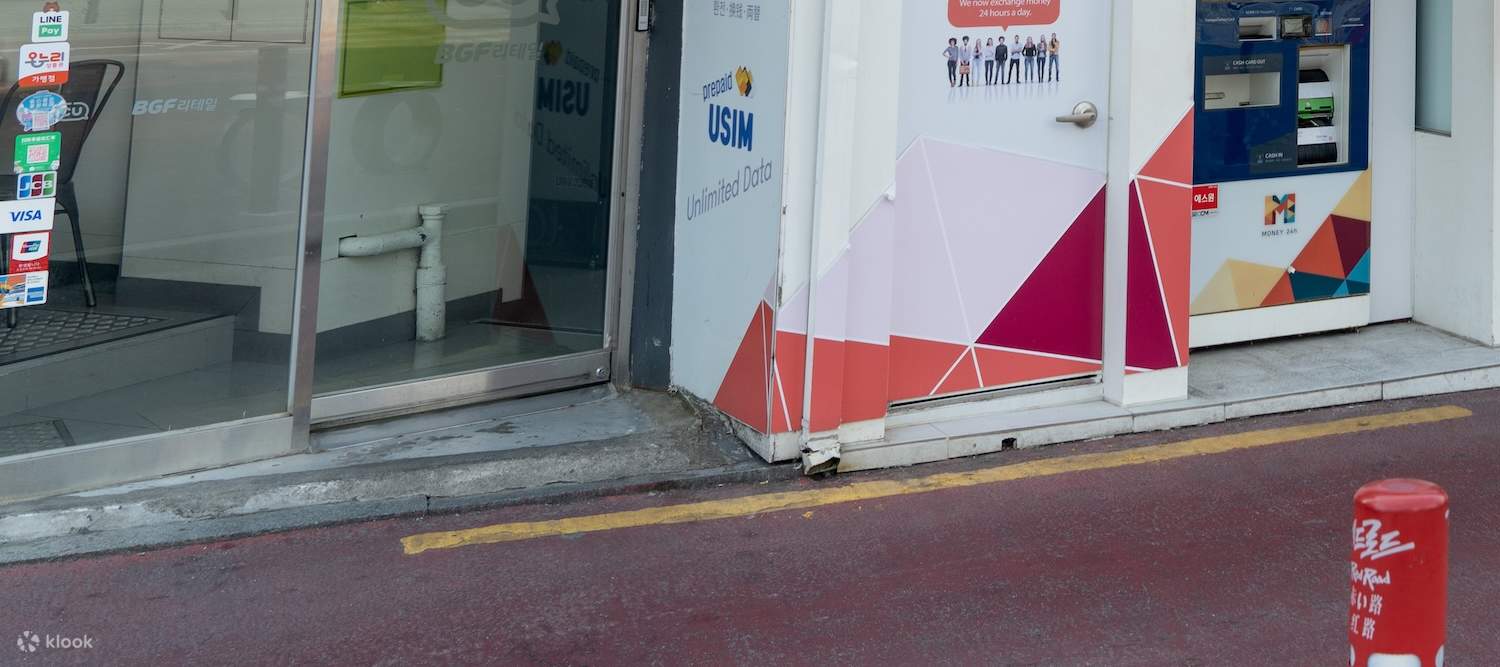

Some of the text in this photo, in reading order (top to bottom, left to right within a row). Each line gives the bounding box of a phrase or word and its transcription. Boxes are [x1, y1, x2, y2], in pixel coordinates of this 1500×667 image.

[979, 9, 988, 17] 24
[989, 8, 1010, 17] hours
[41, 27, 60, 35] Pay
[703, 72, 733, 102] prepaid
[708, 103, 753, 152] USIM
[20, 177, 54, 194] JCB
[687, 157, 773, 221] Unlimited Data
[1194, 192, 1215, 203] 에스원
[11, 210, 42, 222] VISA
[1353, 519, 1416, 560] 드로드
